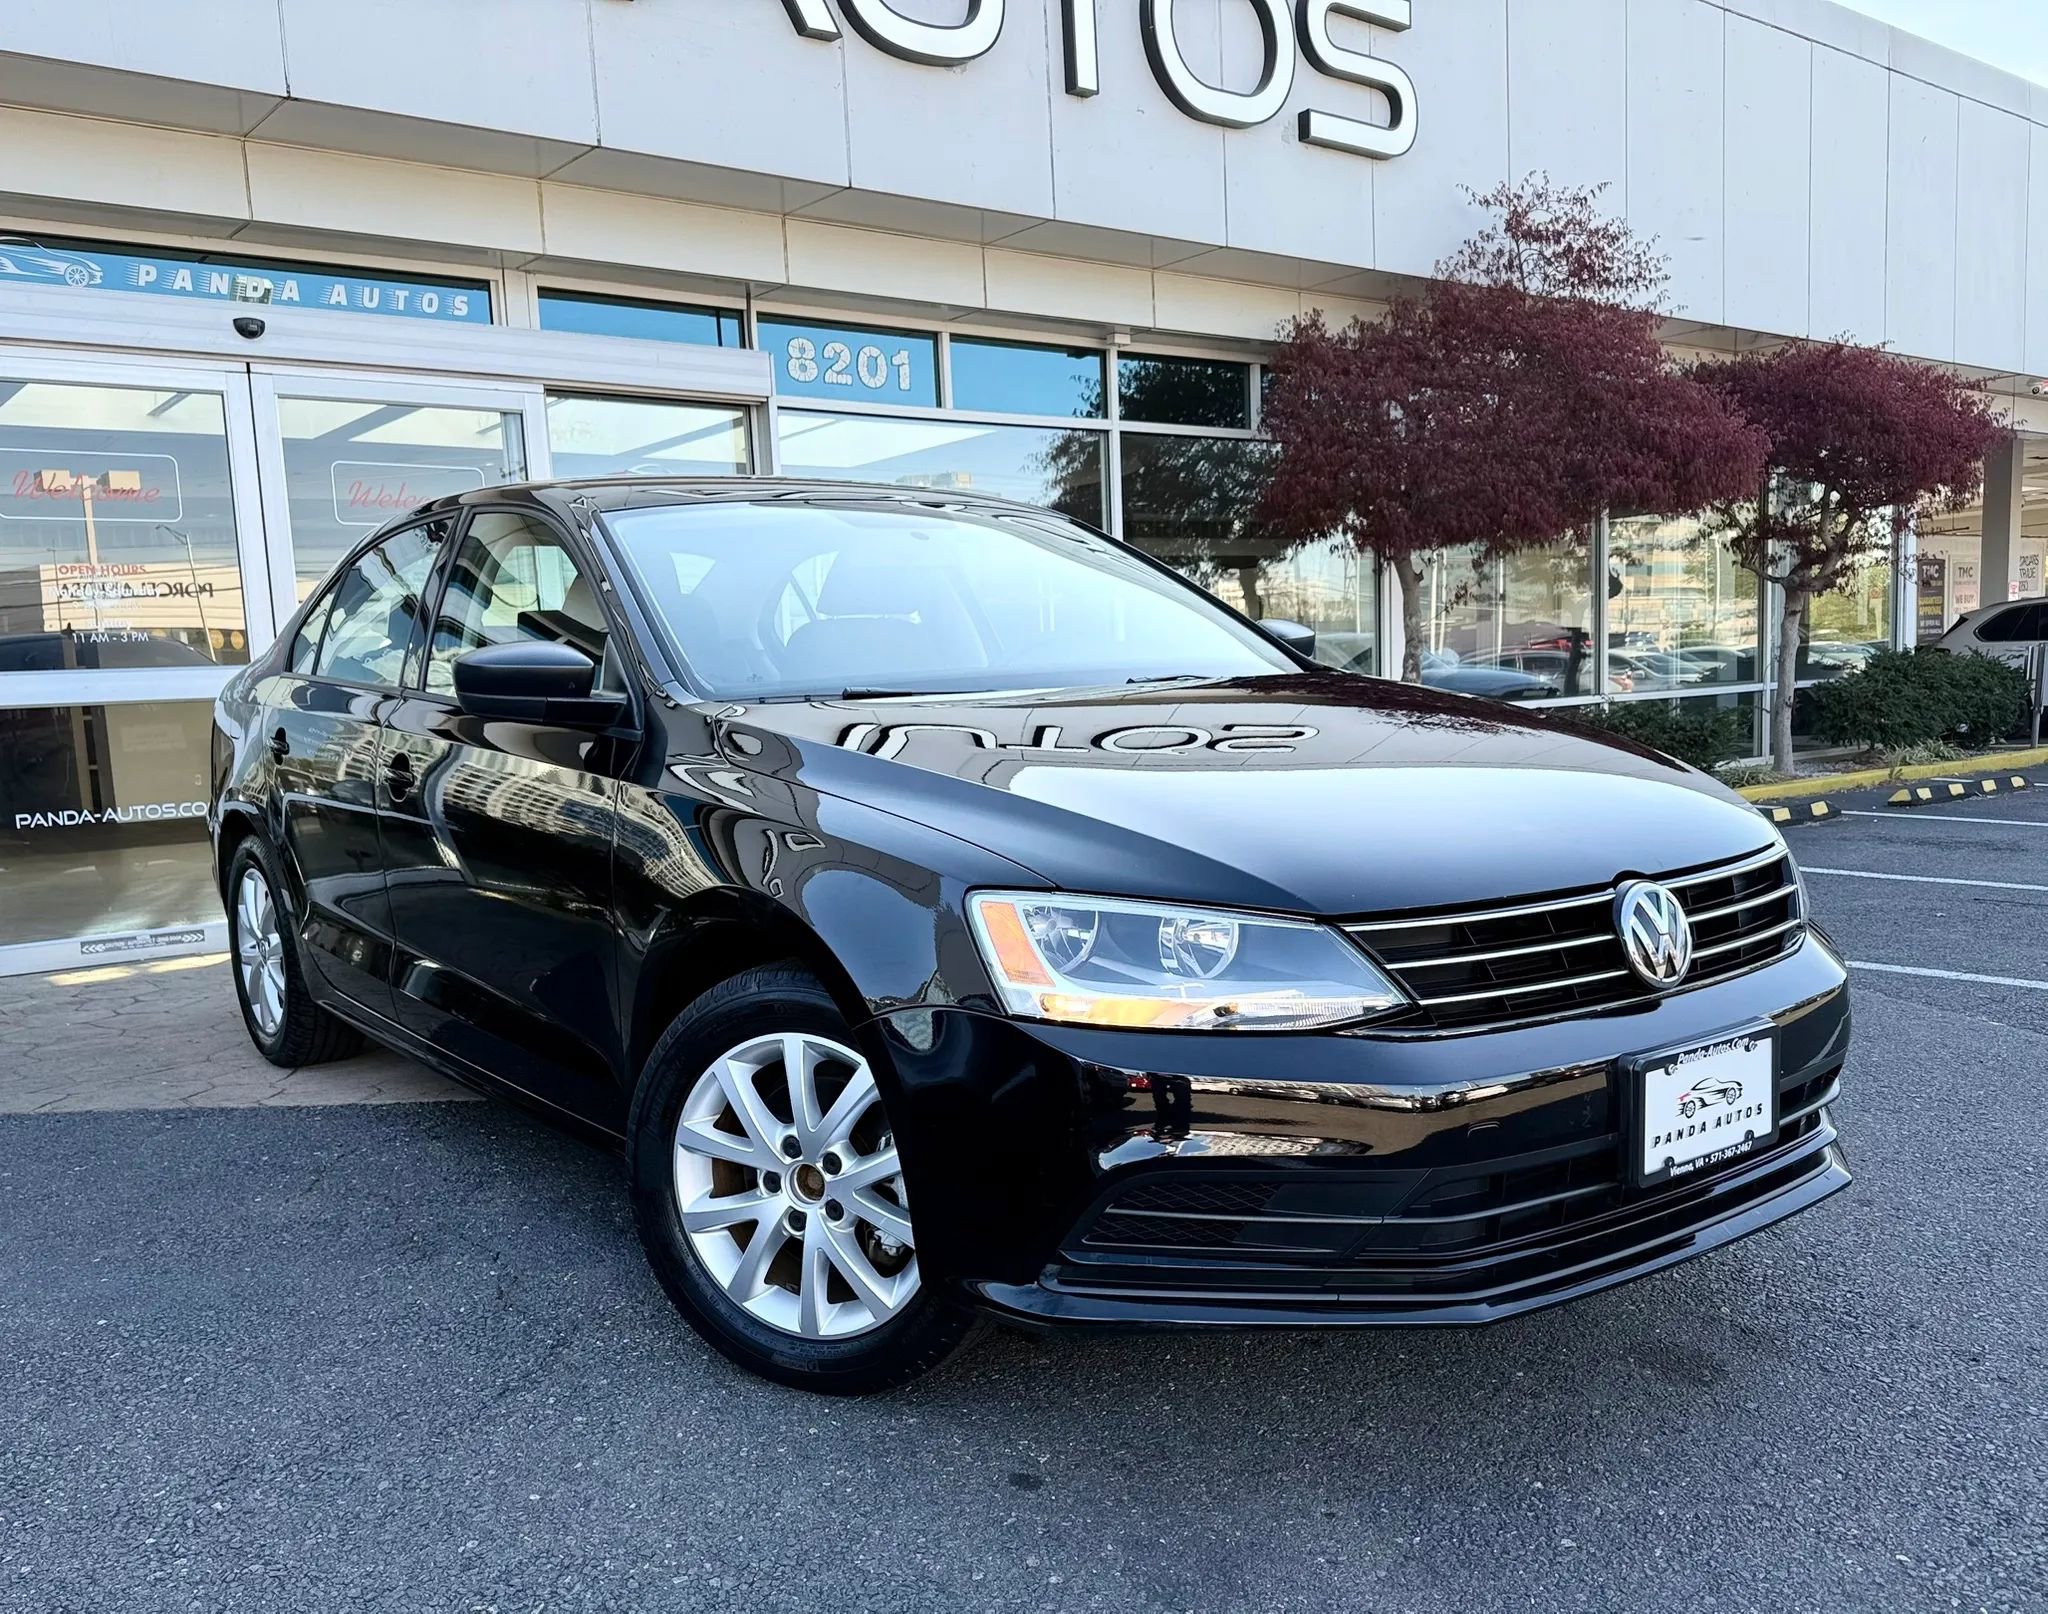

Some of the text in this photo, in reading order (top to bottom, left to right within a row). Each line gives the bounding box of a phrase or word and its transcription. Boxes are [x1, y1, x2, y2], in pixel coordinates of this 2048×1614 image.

[126, 263, 469, 316] PANDA AUTOS
[786, 336, 911, 391] 8201
[348, 479, 434, 509] Welc
[58, 564, 96, 575] OPEN
[101, 564, 147, 576] HOURS
[1958, 566, 1974, 578] TMC
[72, 633, 85, 644] 11
[90, 631, 110, 643] AM
[120, 631, 129, 642] 3
[132, 631, 149, 642] PM
[15, 801, 209, 829] PANDA-AUTOS.CO
[1652, 1102, 1763, 1148] PANDA AUTOS
[1694, 1156, 1705, 1169] VA
